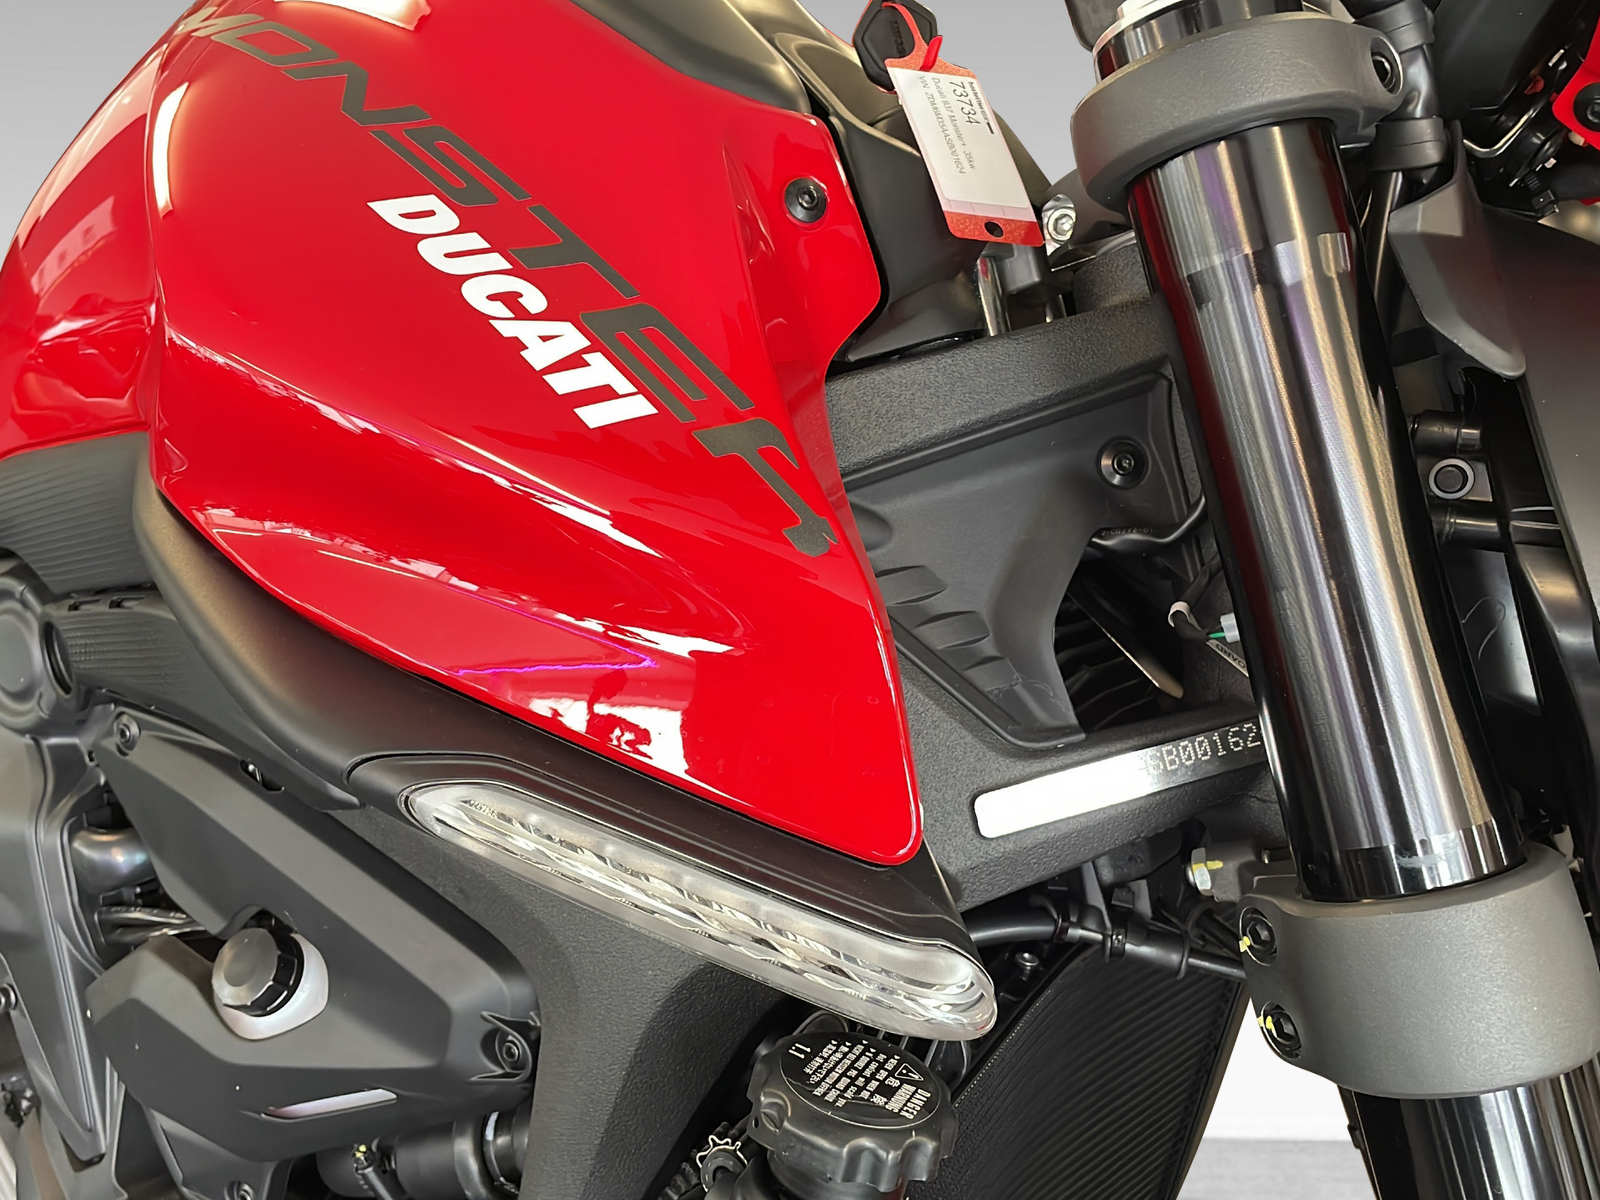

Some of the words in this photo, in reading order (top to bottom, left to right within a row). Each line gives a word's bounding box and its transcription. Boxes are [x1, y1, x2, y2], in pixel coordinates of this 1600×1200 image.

[949, 81, 981, 124] 73734
[172, 6, 838, 557] MONSTER
[366, 194, 659, 429] DUCATI
[898, 1088, 931, 1119] DANGER
